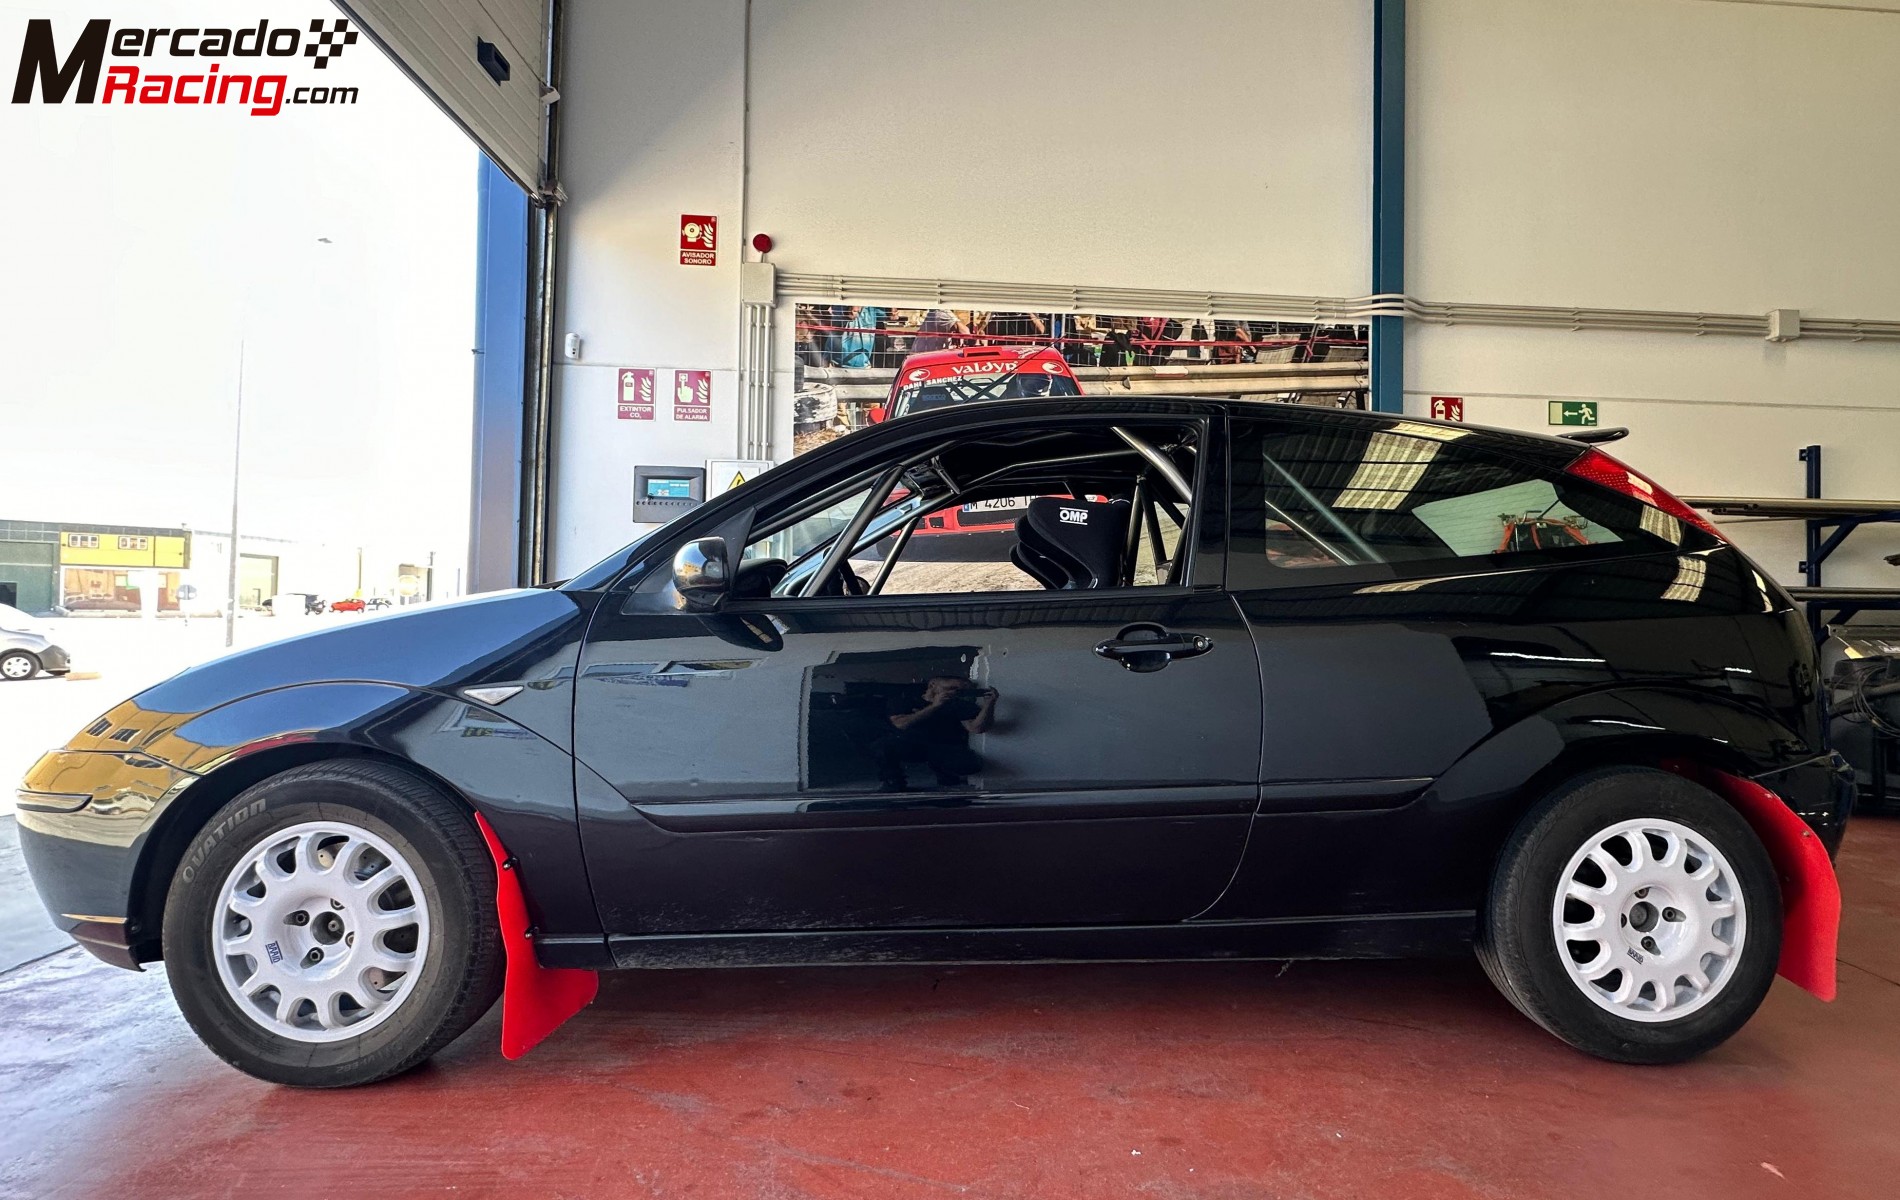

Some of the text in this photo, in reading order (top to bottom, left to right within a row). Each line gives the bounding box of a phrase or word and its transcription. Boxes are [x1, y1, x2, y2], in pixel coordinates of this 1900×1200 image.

[903, 381, 922, 391] DANI
[984, 497, 1016, 509] 4206
[1060, 510, 1088, 523] OMP
